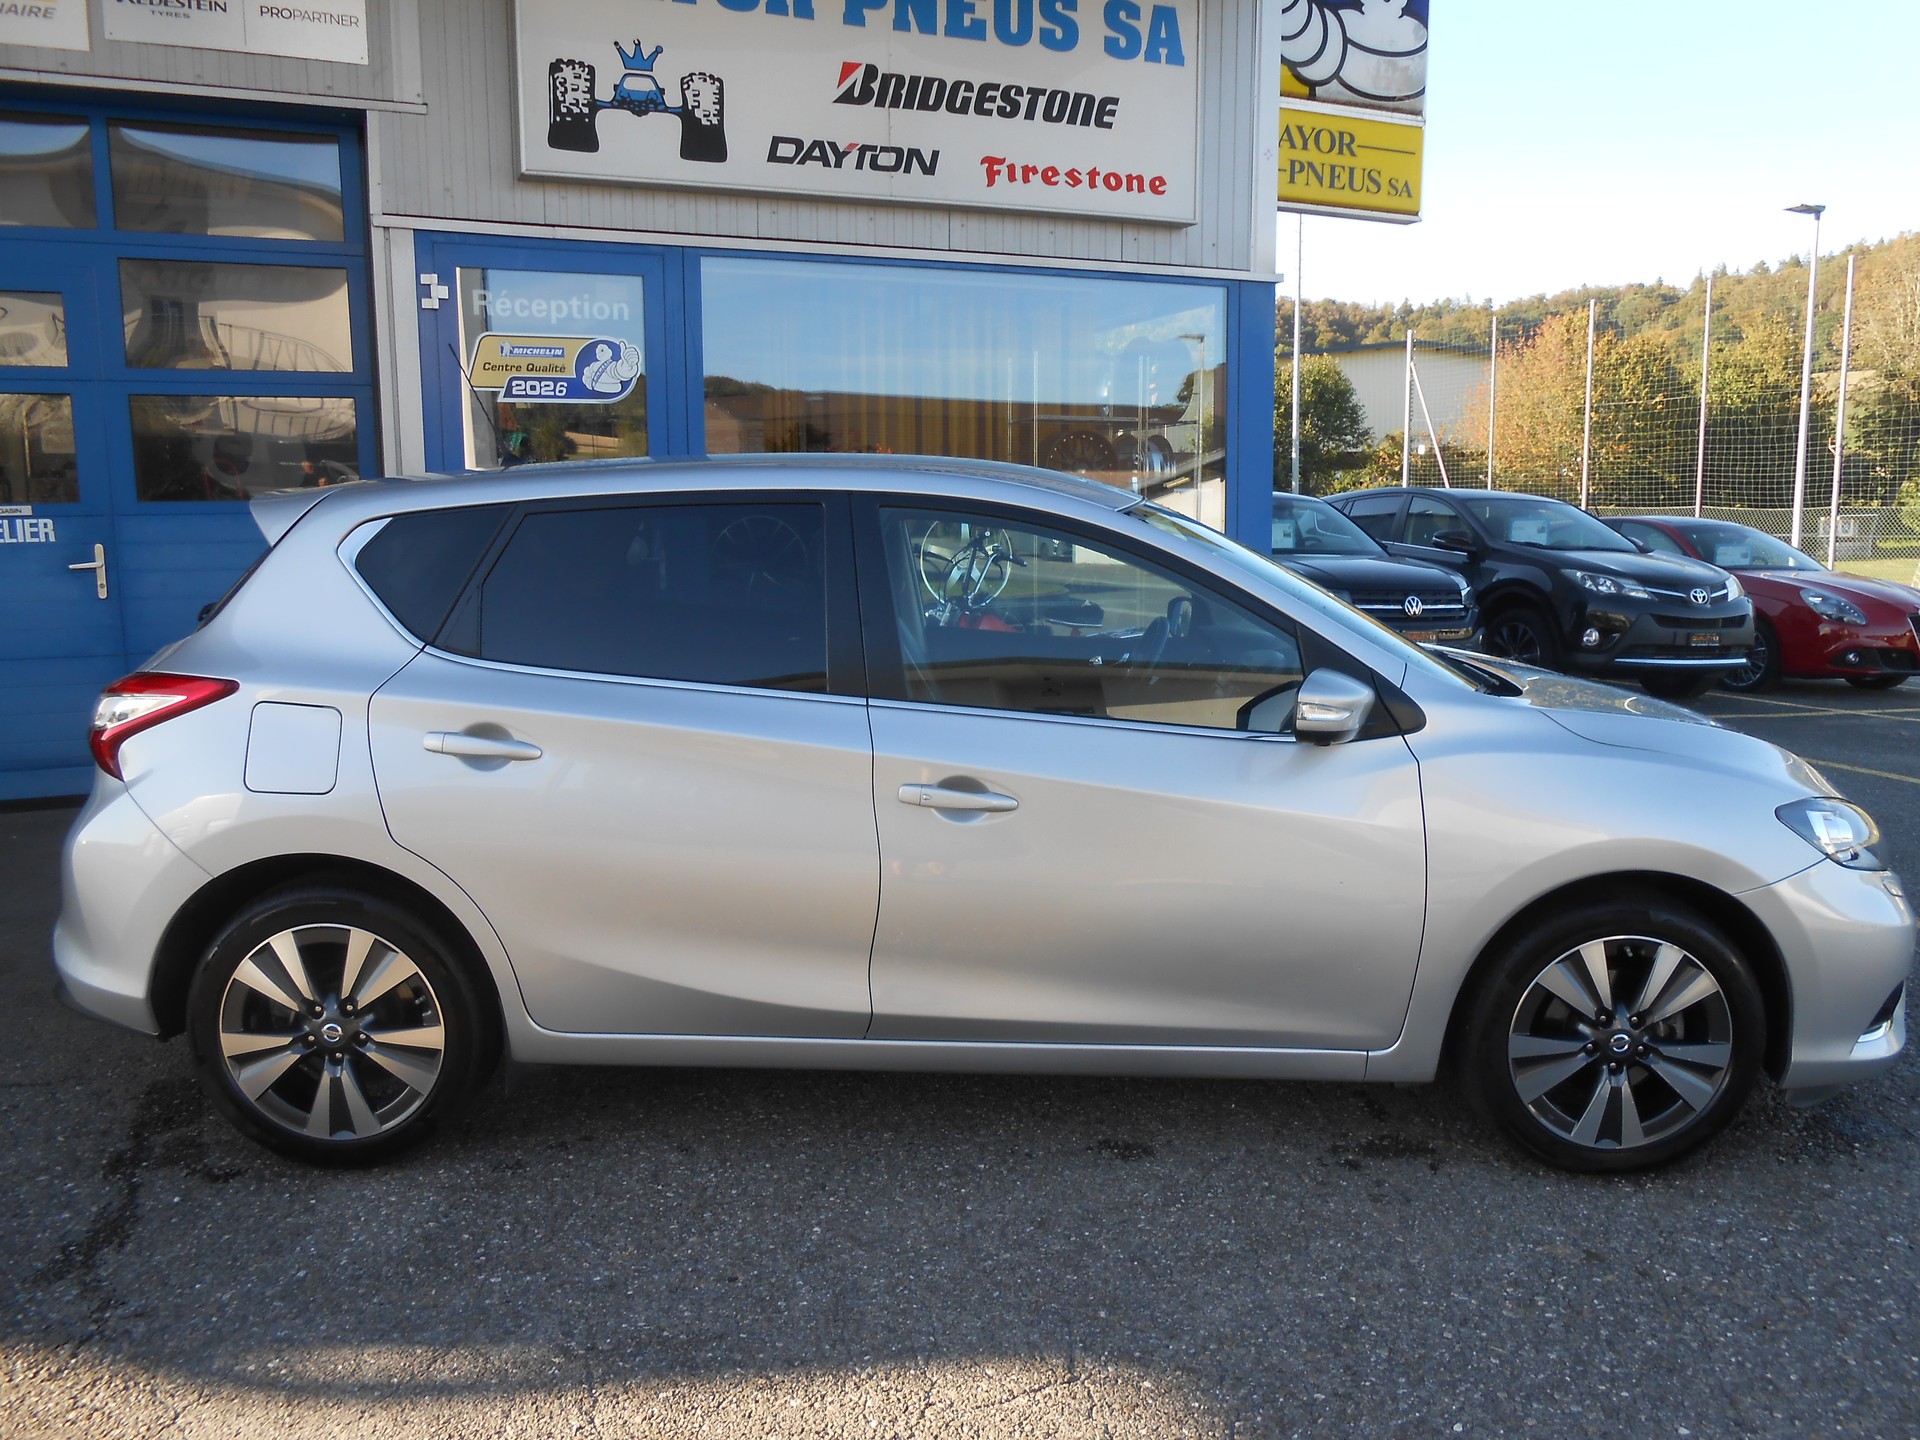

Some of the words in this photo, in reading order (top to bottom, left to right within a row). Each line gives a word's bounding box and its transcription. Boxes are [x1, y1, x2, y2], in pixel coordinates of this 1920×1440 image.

[116, 0, 227, 13] EDESTEIN
[151, 9, 190, 19] TYRES
[260, 5, 359, 27] PROPARTNER
[1103, 0, 1185, 67] SA
[832, 61, 1120, 129] BRIDGESTONE
[767, 135, 940, 176] DAYTON
[980, 155, 1167, 195] Firestone
[1288, 159, 1381, 194] PNEUS
[1387, 177, 1413, 198] SA
[472, 289, 630, 324] Réception
[513, 347, 563, 356] MICHELIN
[483, 362, 522, 373] Centre
[526, 363, 566, 373] Qualité
[511, 380, 568, 397] 2026
